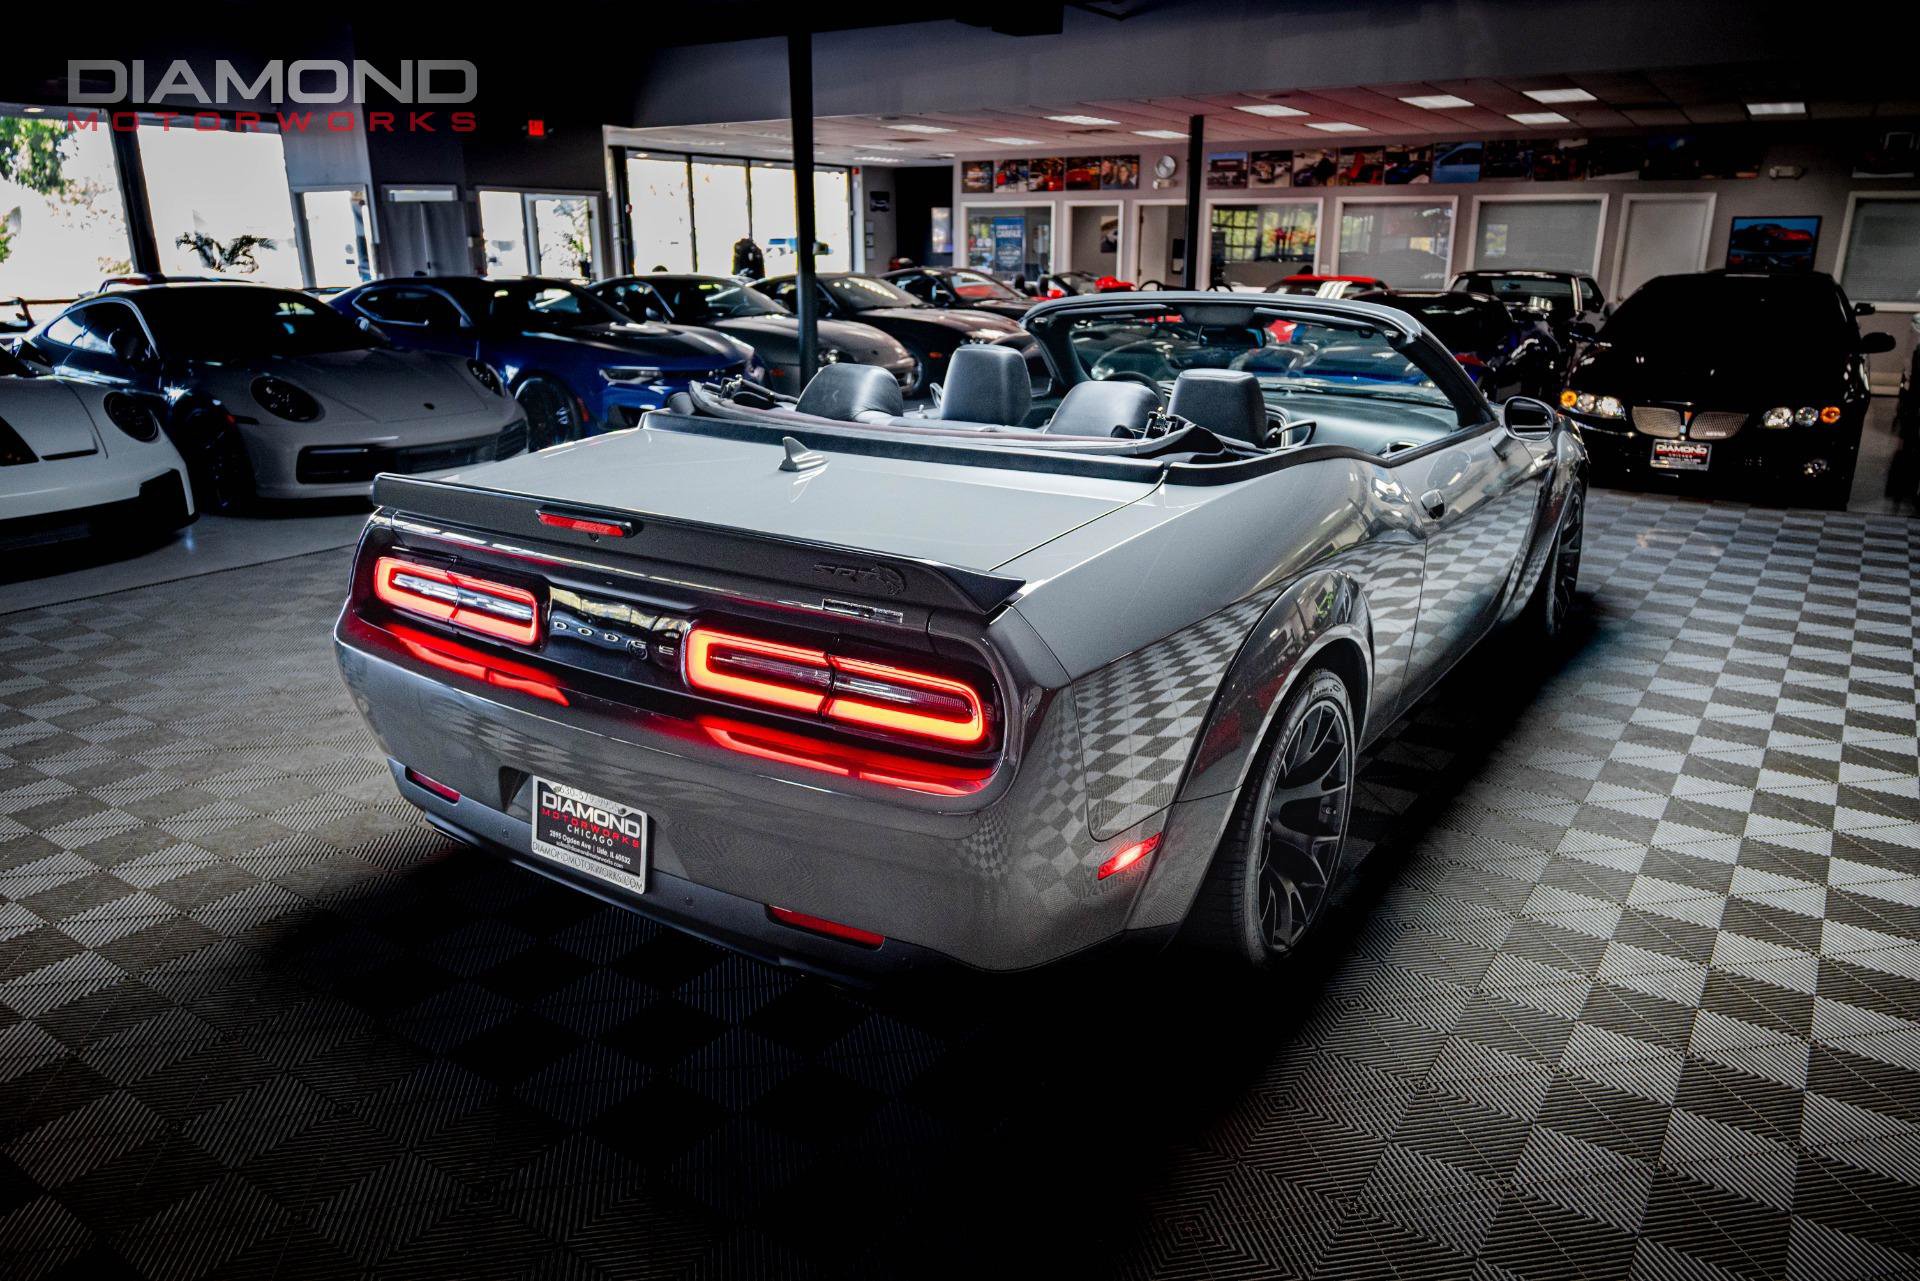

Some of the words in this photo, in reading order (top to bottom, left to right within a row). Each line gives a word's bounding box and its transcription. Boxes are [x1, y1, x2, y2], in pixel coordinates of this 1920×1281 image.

[1656, 444, 1708, 454] DIAMOND
[554, 621, 675, 656] DODGE
[541, 807, 640, 848] MOTORWORKS
[542, 791, 640, 839] DIAMOND
[562, 834, 581, 847] Ogden
[581, 841, 592, 850] Ave
[567, 824, 613, 847] CHICAGO
[532, 841, 643, 892] DIAMONDMOTORWORKS.COM
